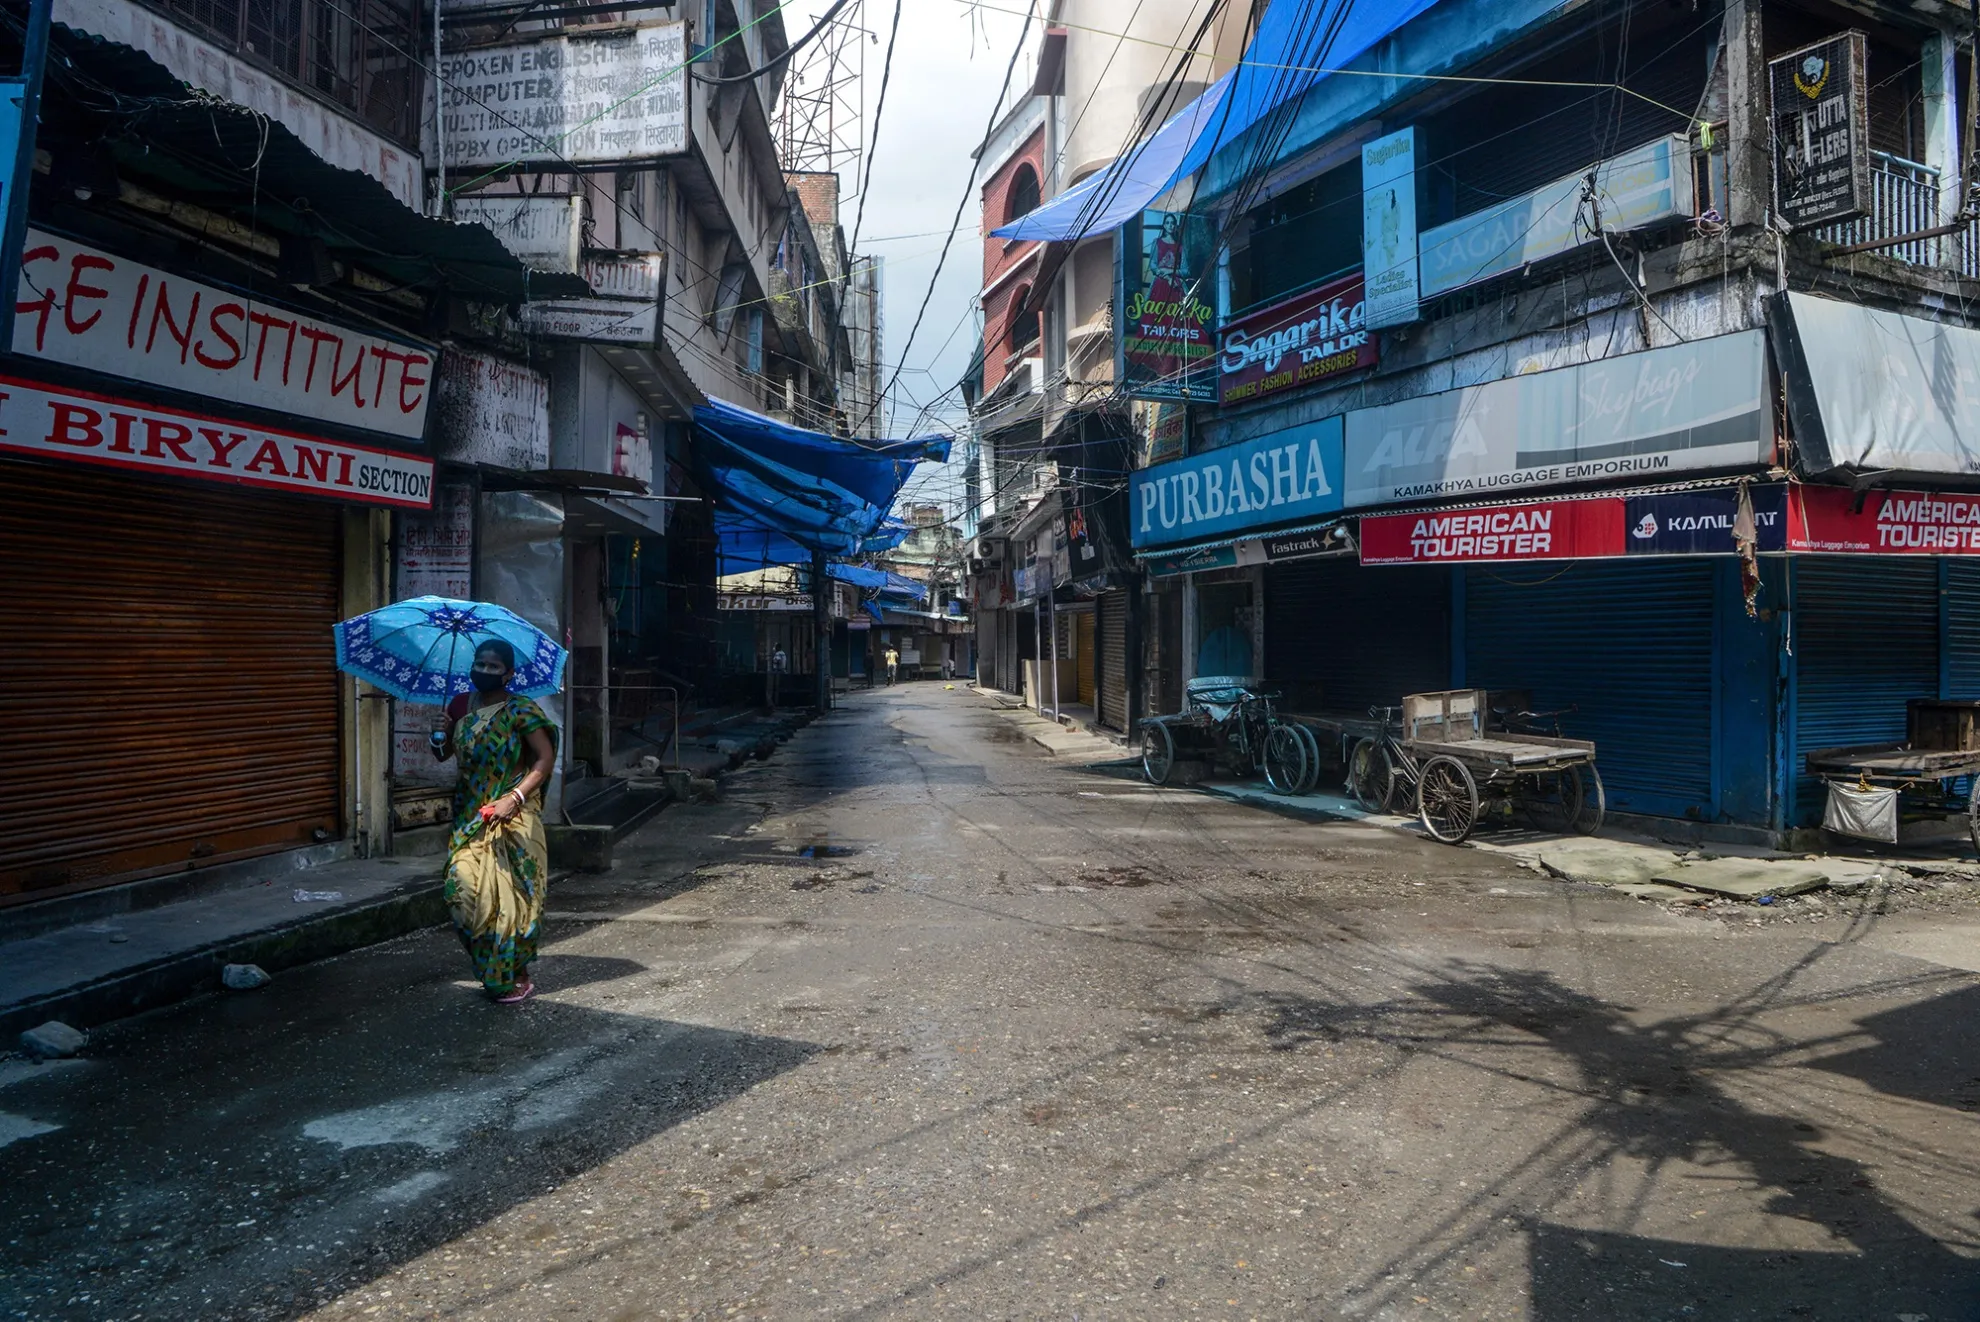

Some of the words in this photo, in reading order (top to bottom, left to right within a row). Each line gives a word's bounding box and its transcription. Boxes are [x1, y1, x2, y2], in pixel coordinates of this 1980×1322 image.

[440, 53, 515, 80] SPOKEN
[440, 78, 554, 108] COMPUTER
[553, 321, 581, 333] FLOOR
[1221, 298, 1365, 373] Sagarika
[128, 273, 430, 415] INSTITUTE
[1259, 370, 1294, 393] FASHION
[1297, 349, 1358, 381] ACCESSORIES
[45, 400, 357, 487] BIRYANI
[358, 464, 431, 498] SECTION
[1139, 438, 1332, 533] PURBASHA
[1393, 477, 1475, 498] KAMAKHYA
[1477, 466, 1560, 489] LUGGAGE
[1565, 454, 1669, 480] EMPORIUM
[1410, 510, 1552, 539] AMERICAN
[1668, 511, 1778, 532] KAMILINT
[1271, 537, 1320, 554] fastrack
[1410, 532, 1551, 557] TOURISTER
[1791, 539, 1820, 550] Kamahya
[1821, 540, 1843, 550] Luggage
[1844, 542, 1870, 550] Emporium
